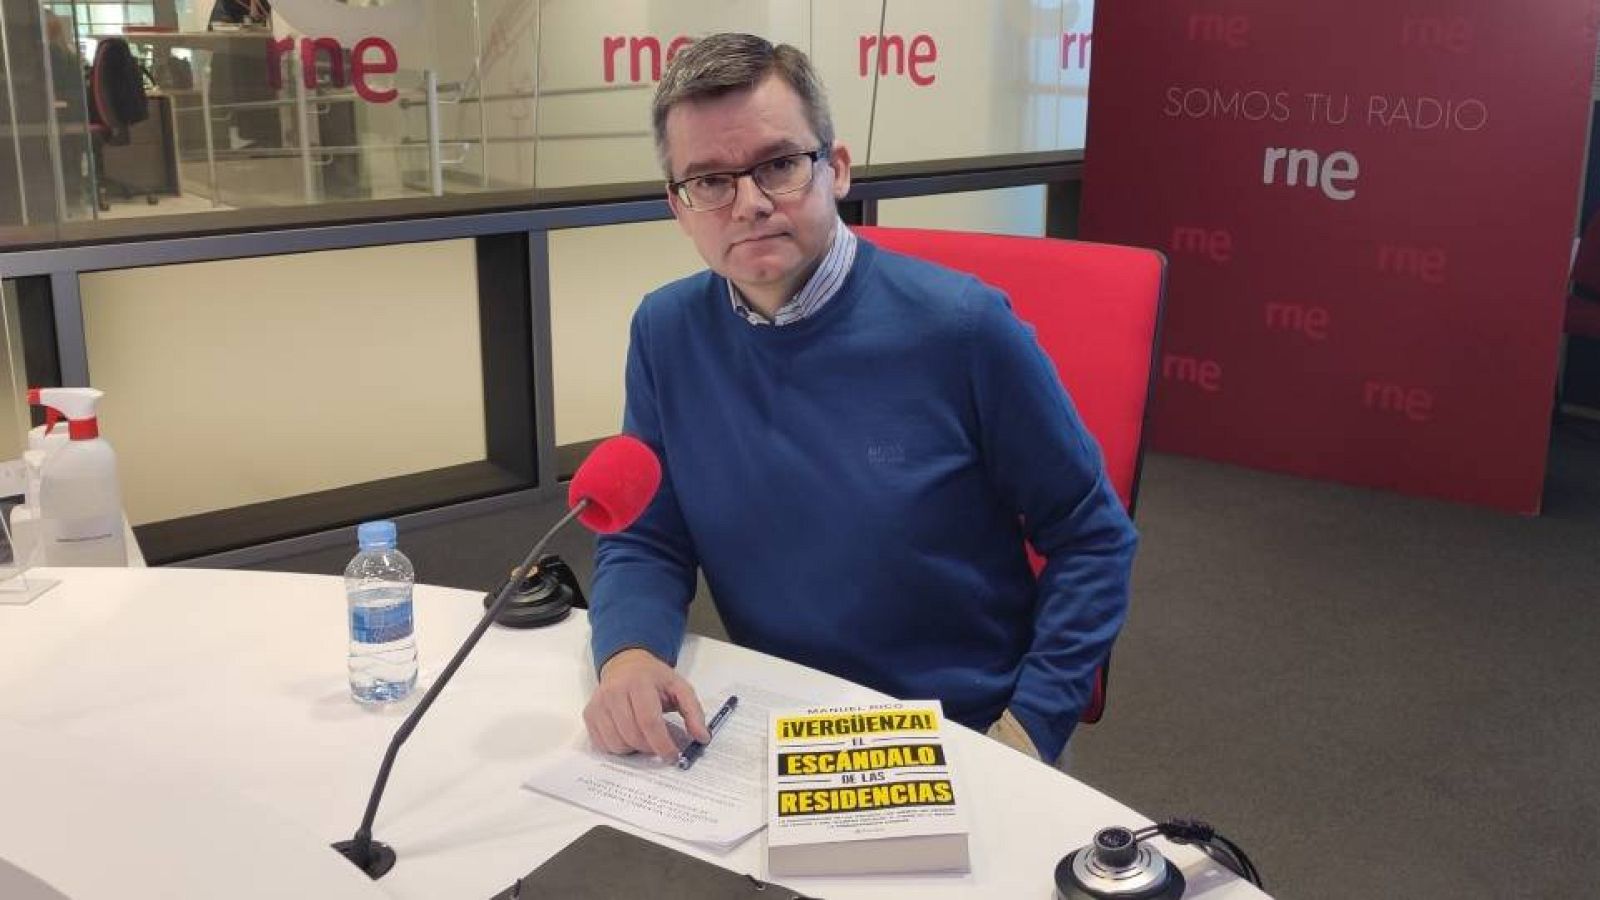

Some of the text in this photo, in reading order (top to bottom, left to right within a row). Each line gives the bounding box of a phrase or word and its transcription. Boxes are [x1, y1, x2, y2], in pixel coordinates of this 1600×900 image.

[266, 36, 398, 104] rne
[859, 34, 936, 86] rne
[1164, 86, 1488, 131] SOMOS TU RADIO
[1263, 145, 1359, 200] rne
[1173, 226, 1231, 261] rne
[1378, 242, 1446, 282] rne
[1265, 301, 1329, 340] rne
[1163, 354, 1222, 392] rne
[1363, 380, 1432, 420] rne
[783, 714, 932, 737] ¡VERGÜENZA!
[787, 747, 935, 774] ESCÁNDALO
[841, 771, 886, 784] DE LAS
[781, 782, 952, 813] RESIDENCIAS
